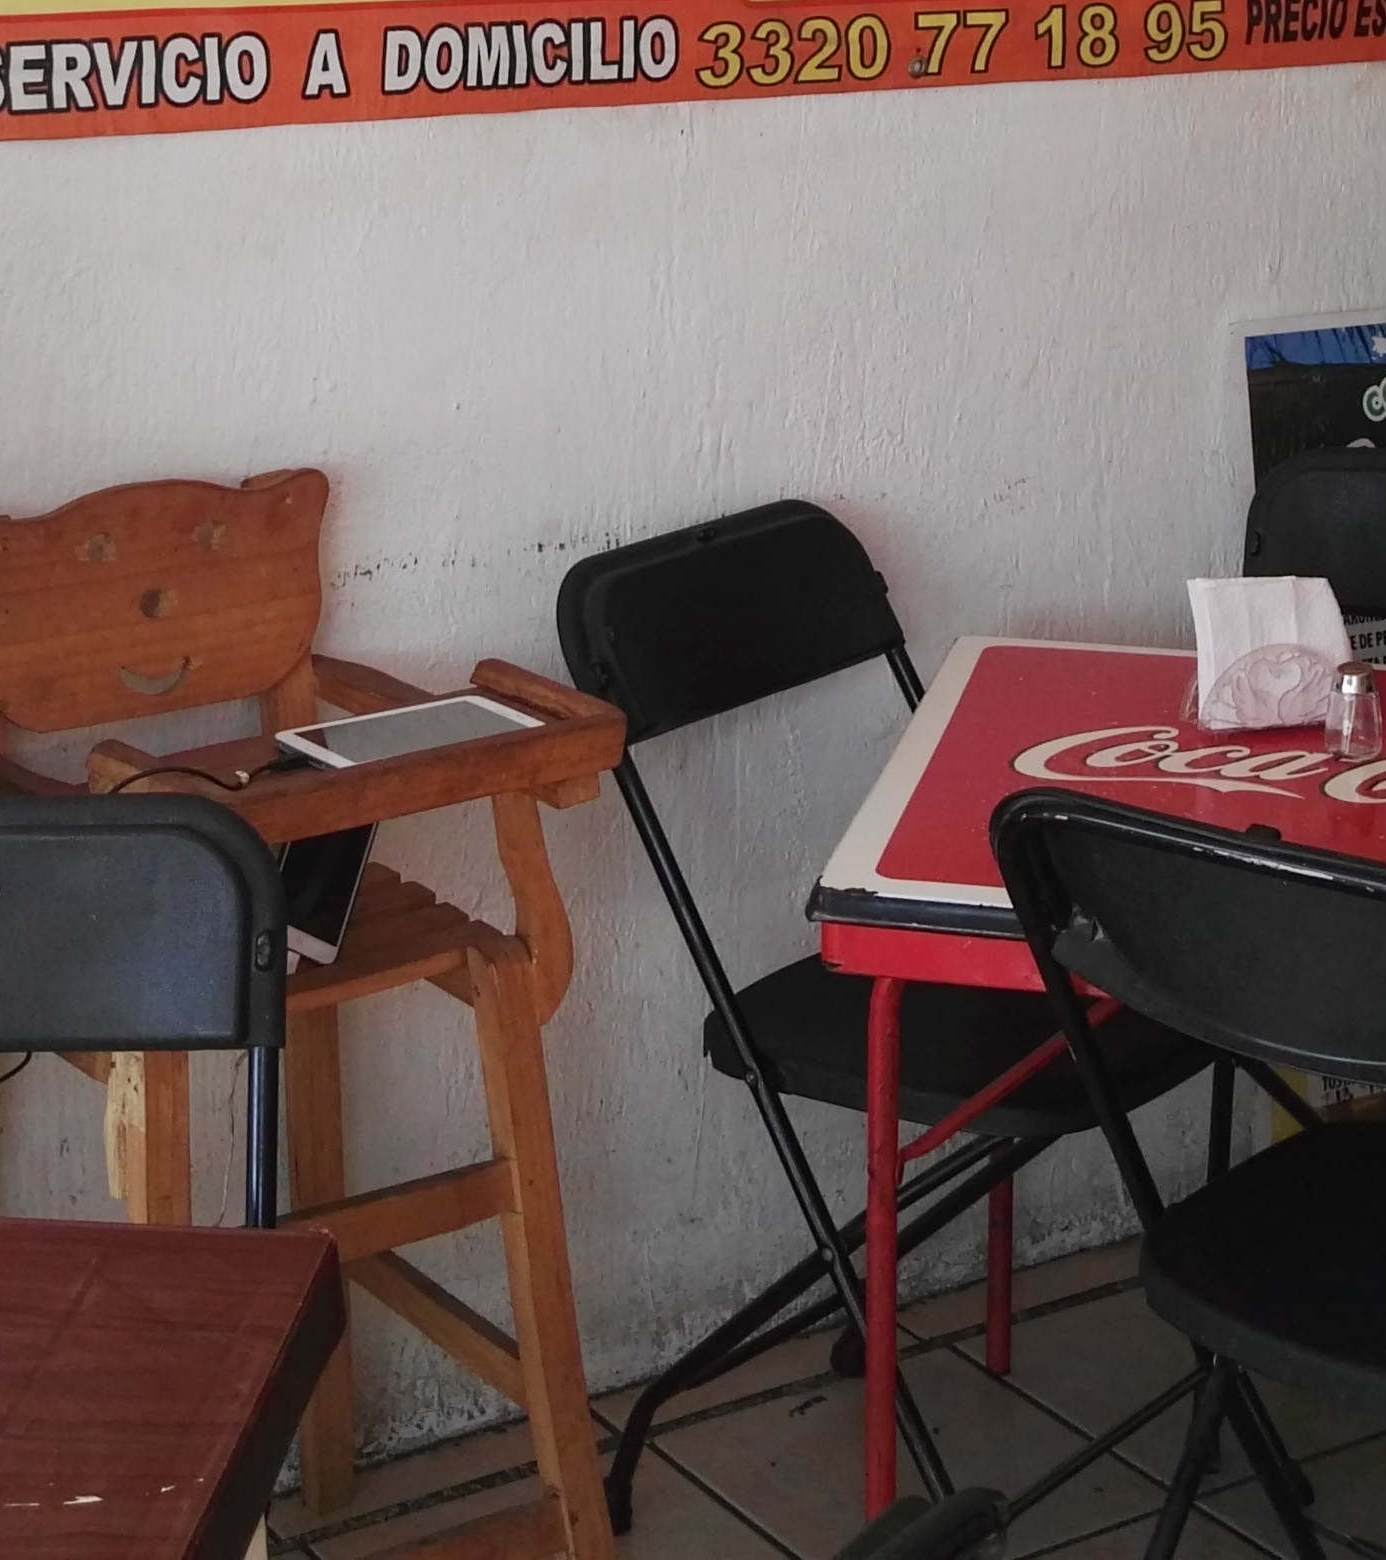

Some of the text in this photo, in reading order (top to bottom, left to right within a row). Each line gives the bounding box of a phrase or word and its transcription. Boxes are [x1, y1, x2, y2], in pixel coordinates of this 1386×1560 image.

[301, 27, 349, 98] A
[382, 16, 680, 92] DOMICILIO
[695, 13, 892, 89] 3320
[913, 9, 1009, 76] 77
[1034, 3, 1119, 69] 18
[1359, 633, 1374, 650] DE
